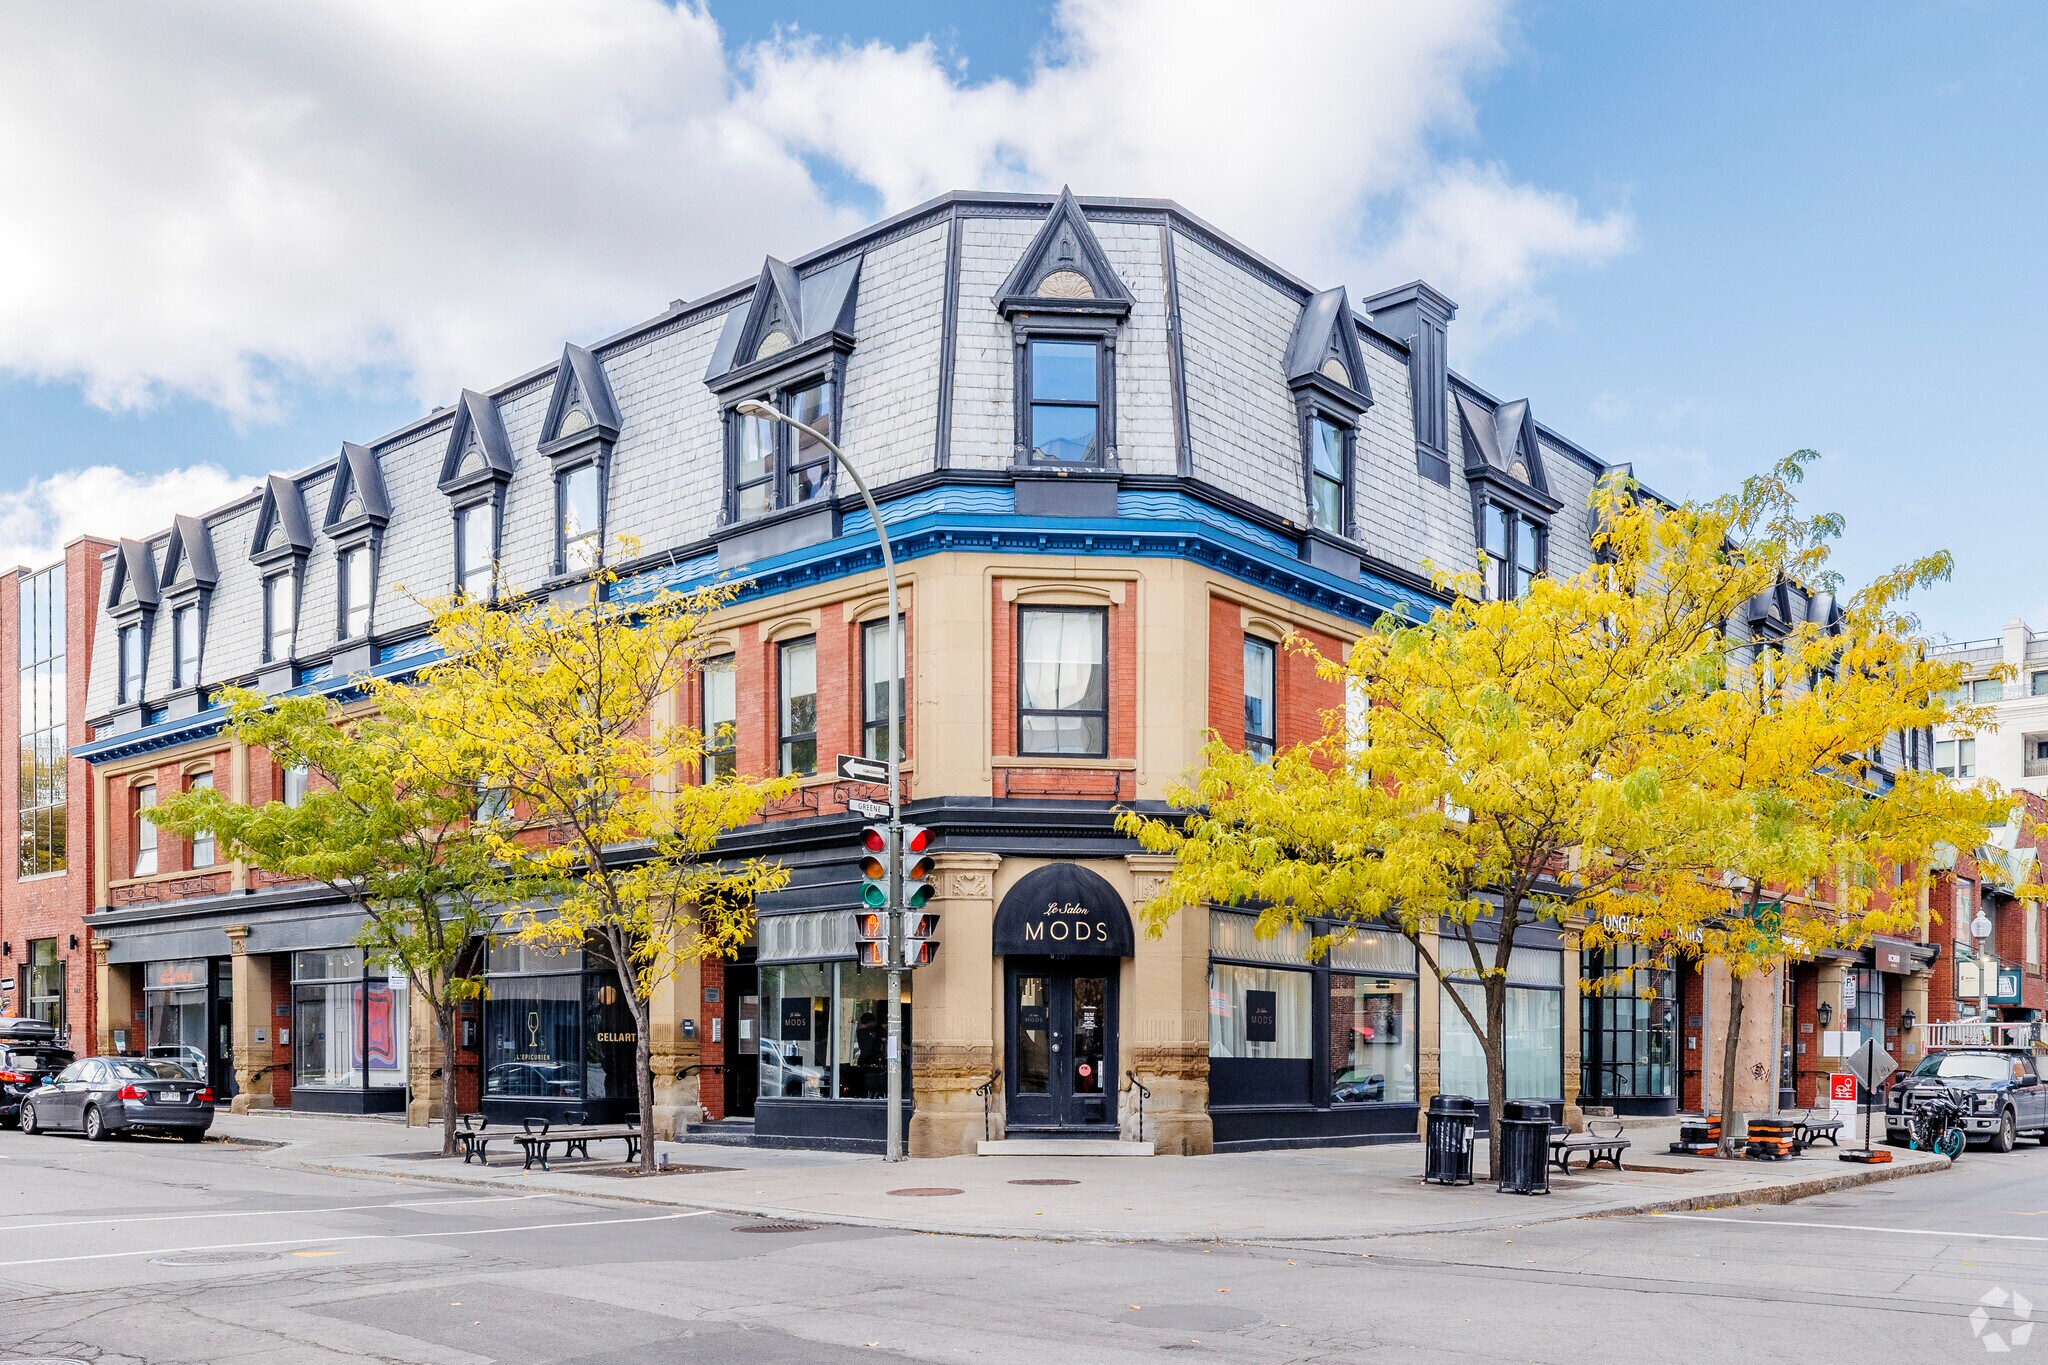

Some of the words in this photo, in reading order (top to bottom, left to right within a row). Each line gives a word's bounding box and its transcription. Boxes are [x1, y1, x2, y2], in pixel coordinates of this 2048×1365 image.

[857, 802, 882, 813] GREENE
[1043, 902, 1058, 916] Le
[1058, 902, 1090, 915] Salon
[1024, 920, 1108, 942] MODS
[784, 1018, 807, 1026] MODS
[1251, 1015, 1273, 1025] MODS
[597, 1032, 636, 1042] CELLART
